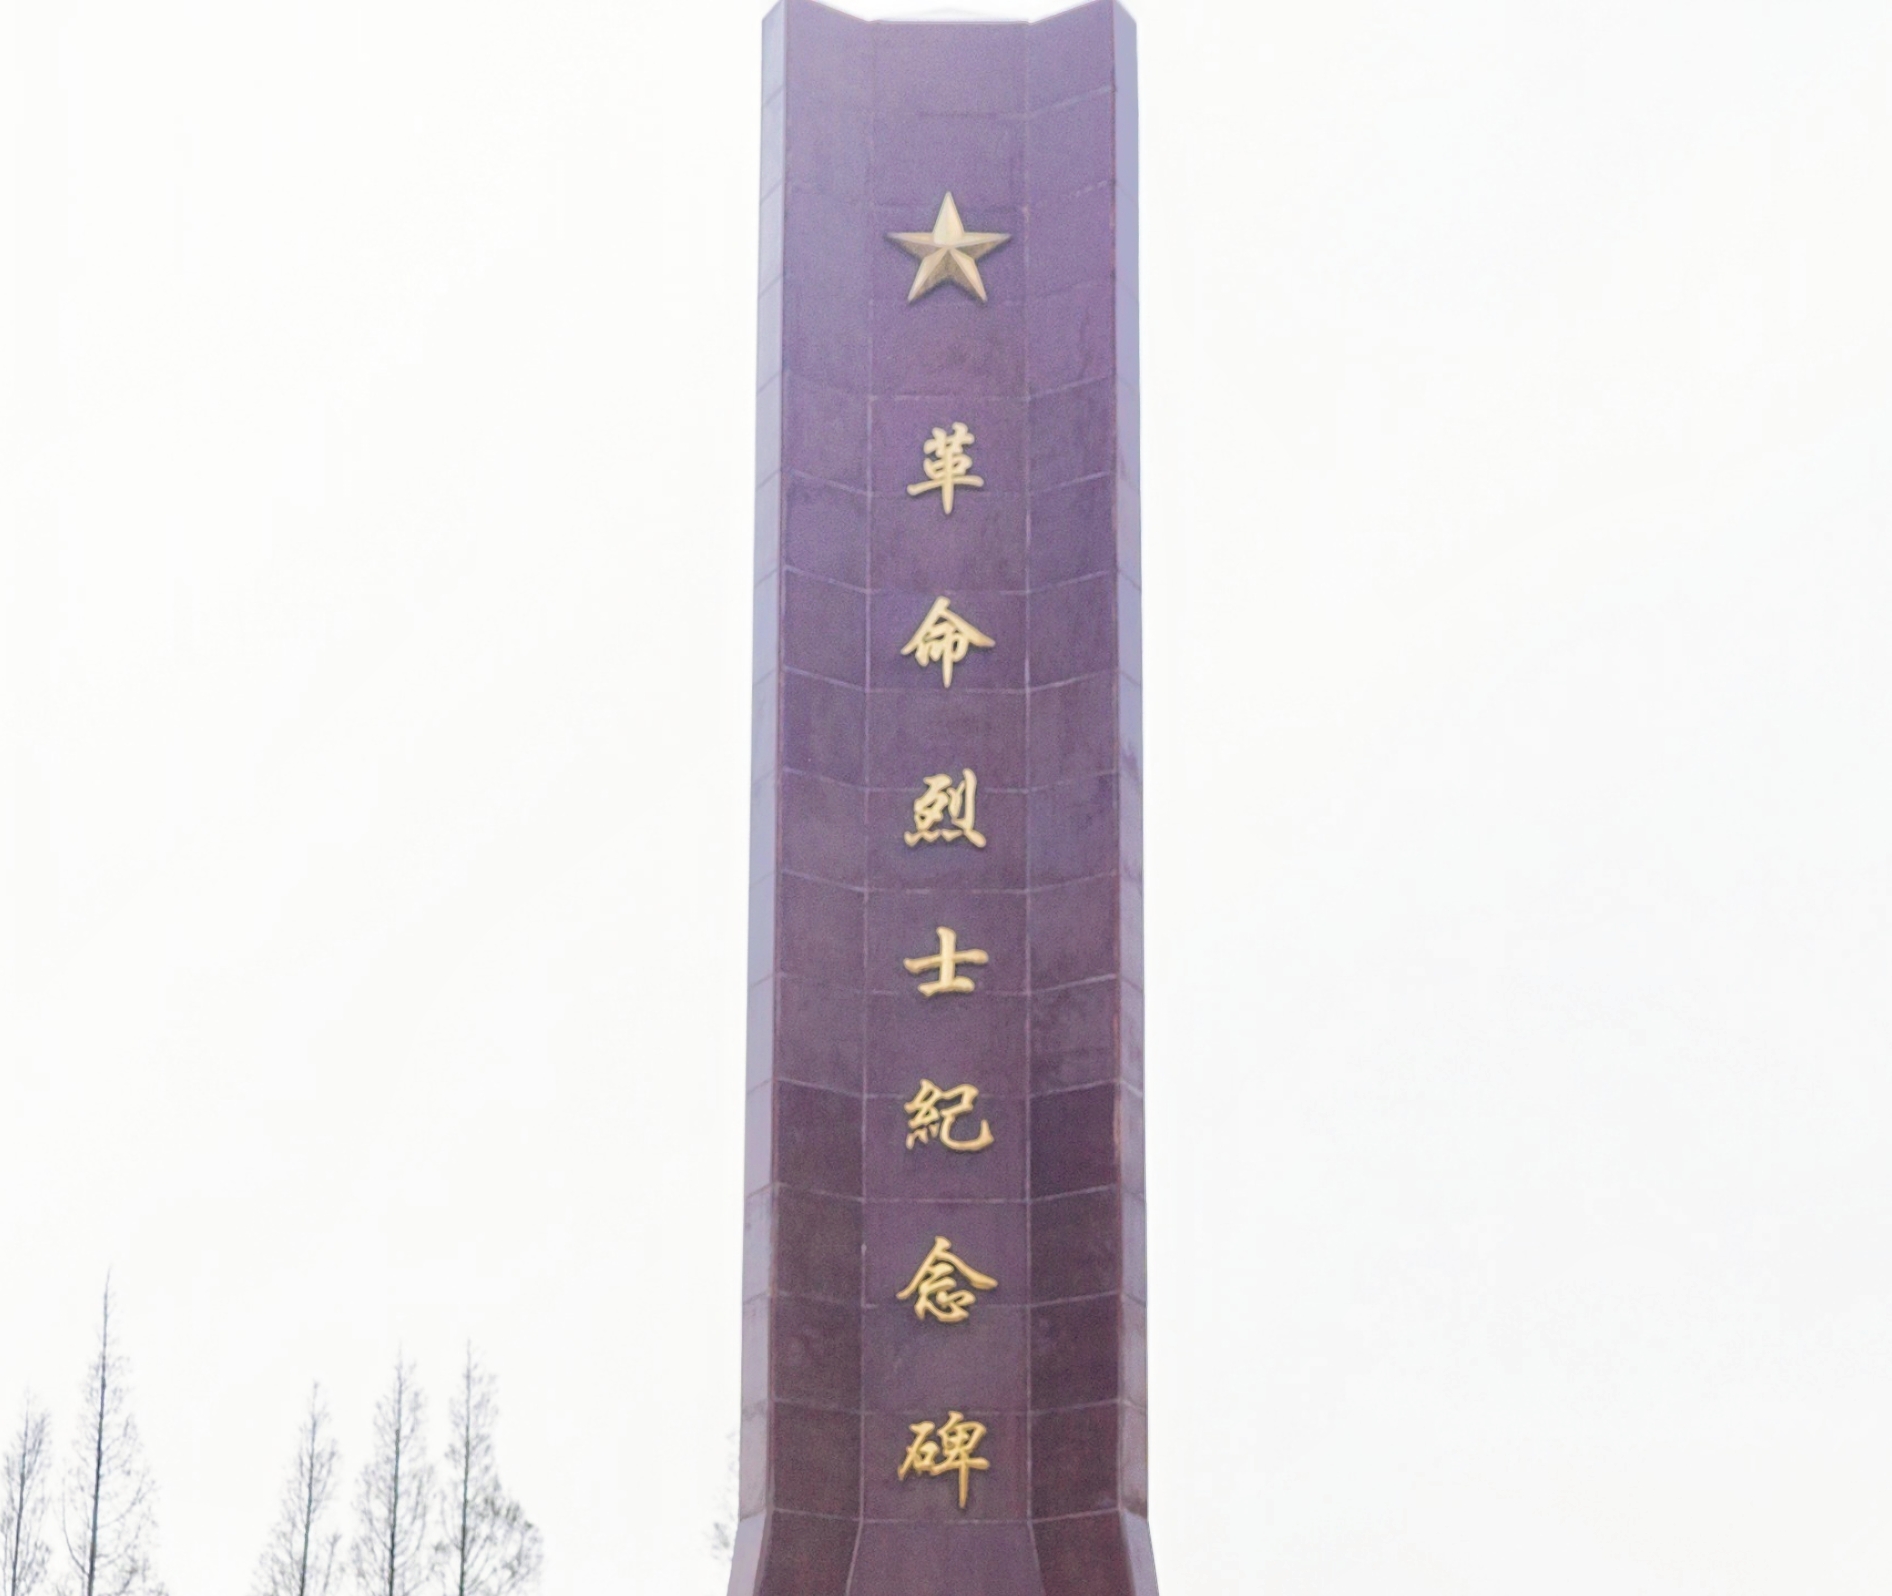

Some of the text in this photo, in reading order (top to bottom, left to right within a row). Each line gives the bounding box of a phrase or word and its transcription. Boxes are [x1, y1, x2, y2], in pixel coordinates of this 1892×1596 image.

[896, 421, 999, 1509] 革命烈士紀念碑
